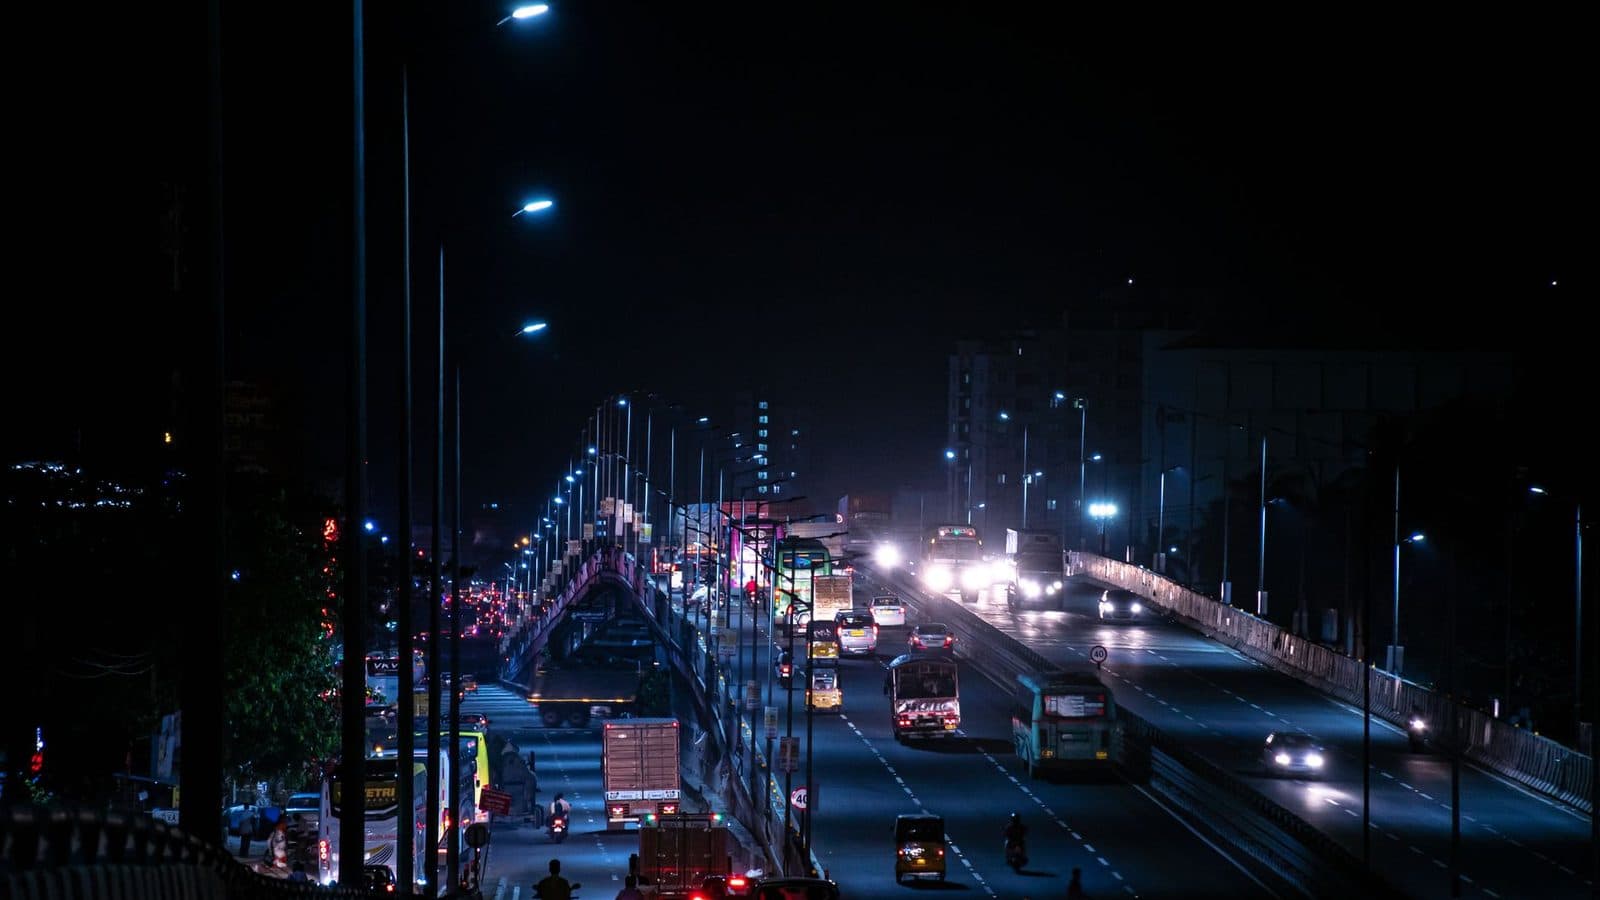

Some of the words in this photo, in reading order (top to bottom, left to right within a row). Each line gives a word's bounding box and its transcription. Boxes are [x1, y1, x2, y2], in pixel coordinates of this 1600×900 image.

[1094, 650, 1104, 658] 40
[364, 787, 396, 798] ETRI
[796, 794, 808, 804] 40
